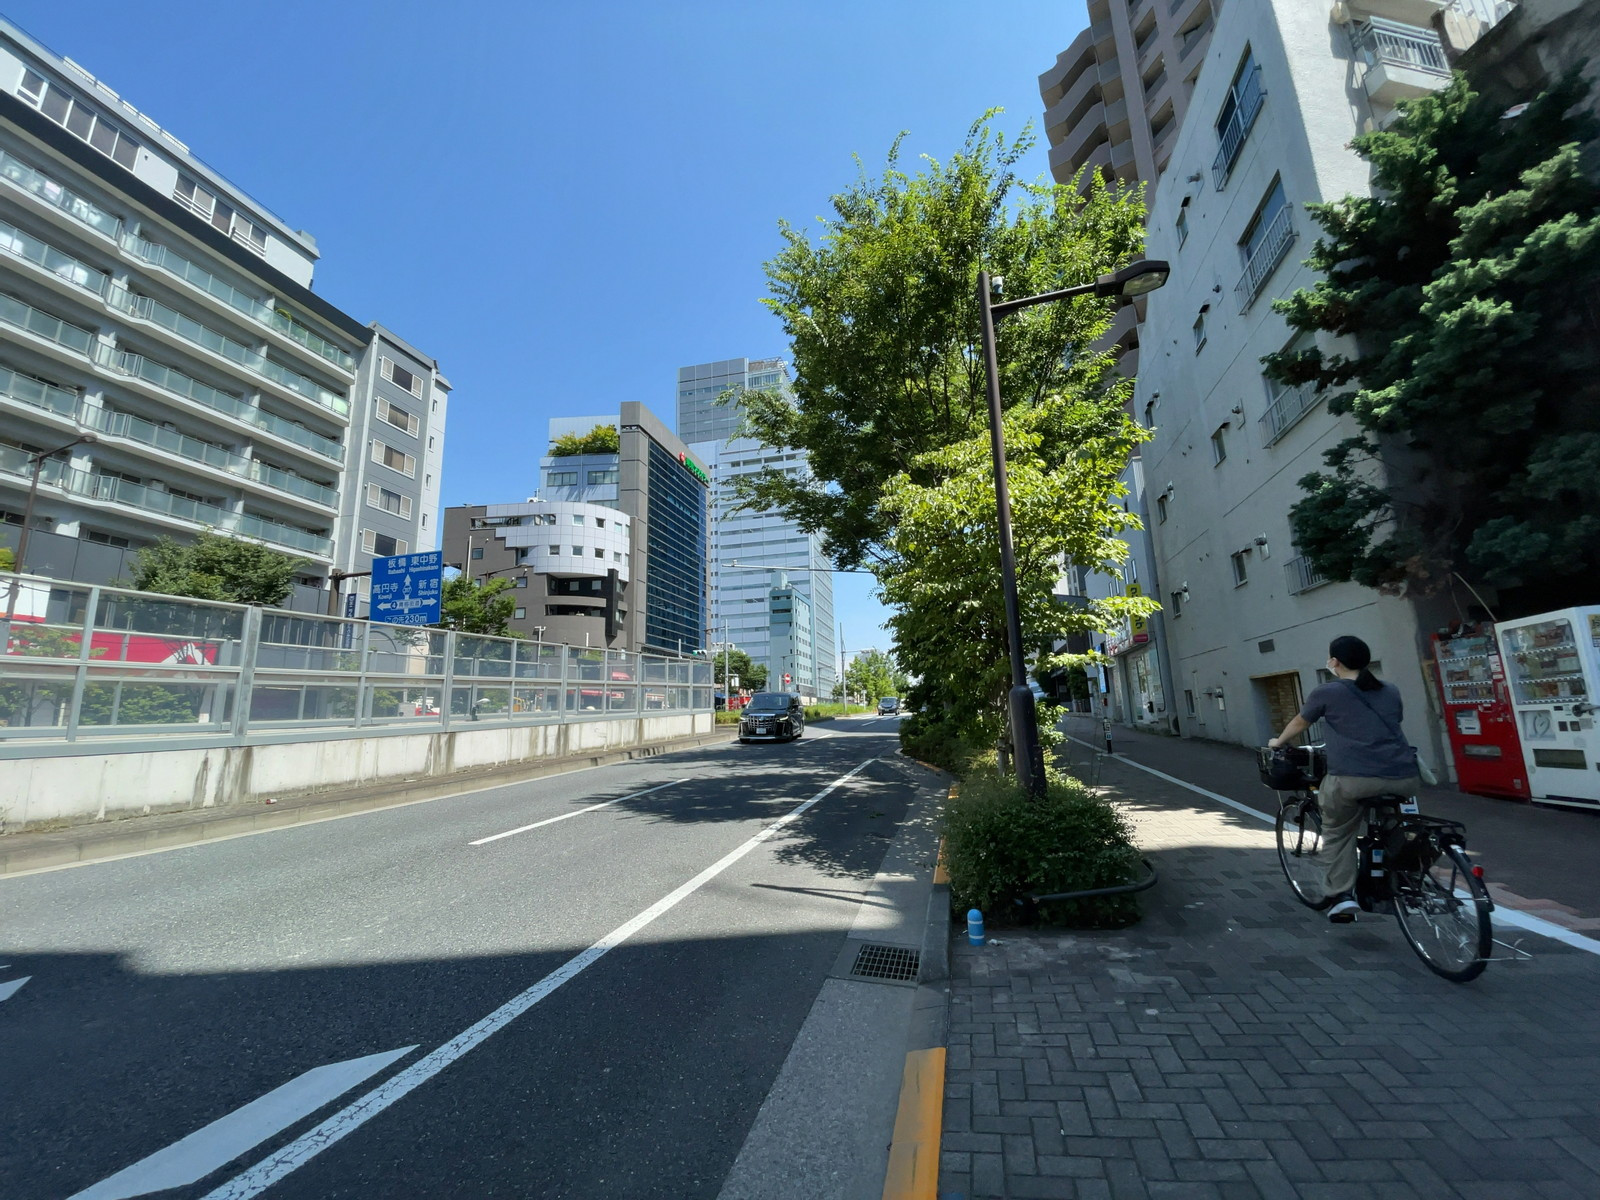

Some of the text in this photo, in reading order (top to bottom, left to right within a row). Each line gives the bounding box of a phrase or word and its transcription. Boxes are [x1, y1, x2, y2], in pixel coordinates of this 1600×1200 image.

[388, 554, 437, 568] 板橋 東中野
[373, 583, 398, 594] 高円寺
[418, 579, 438, 588] 新宿
